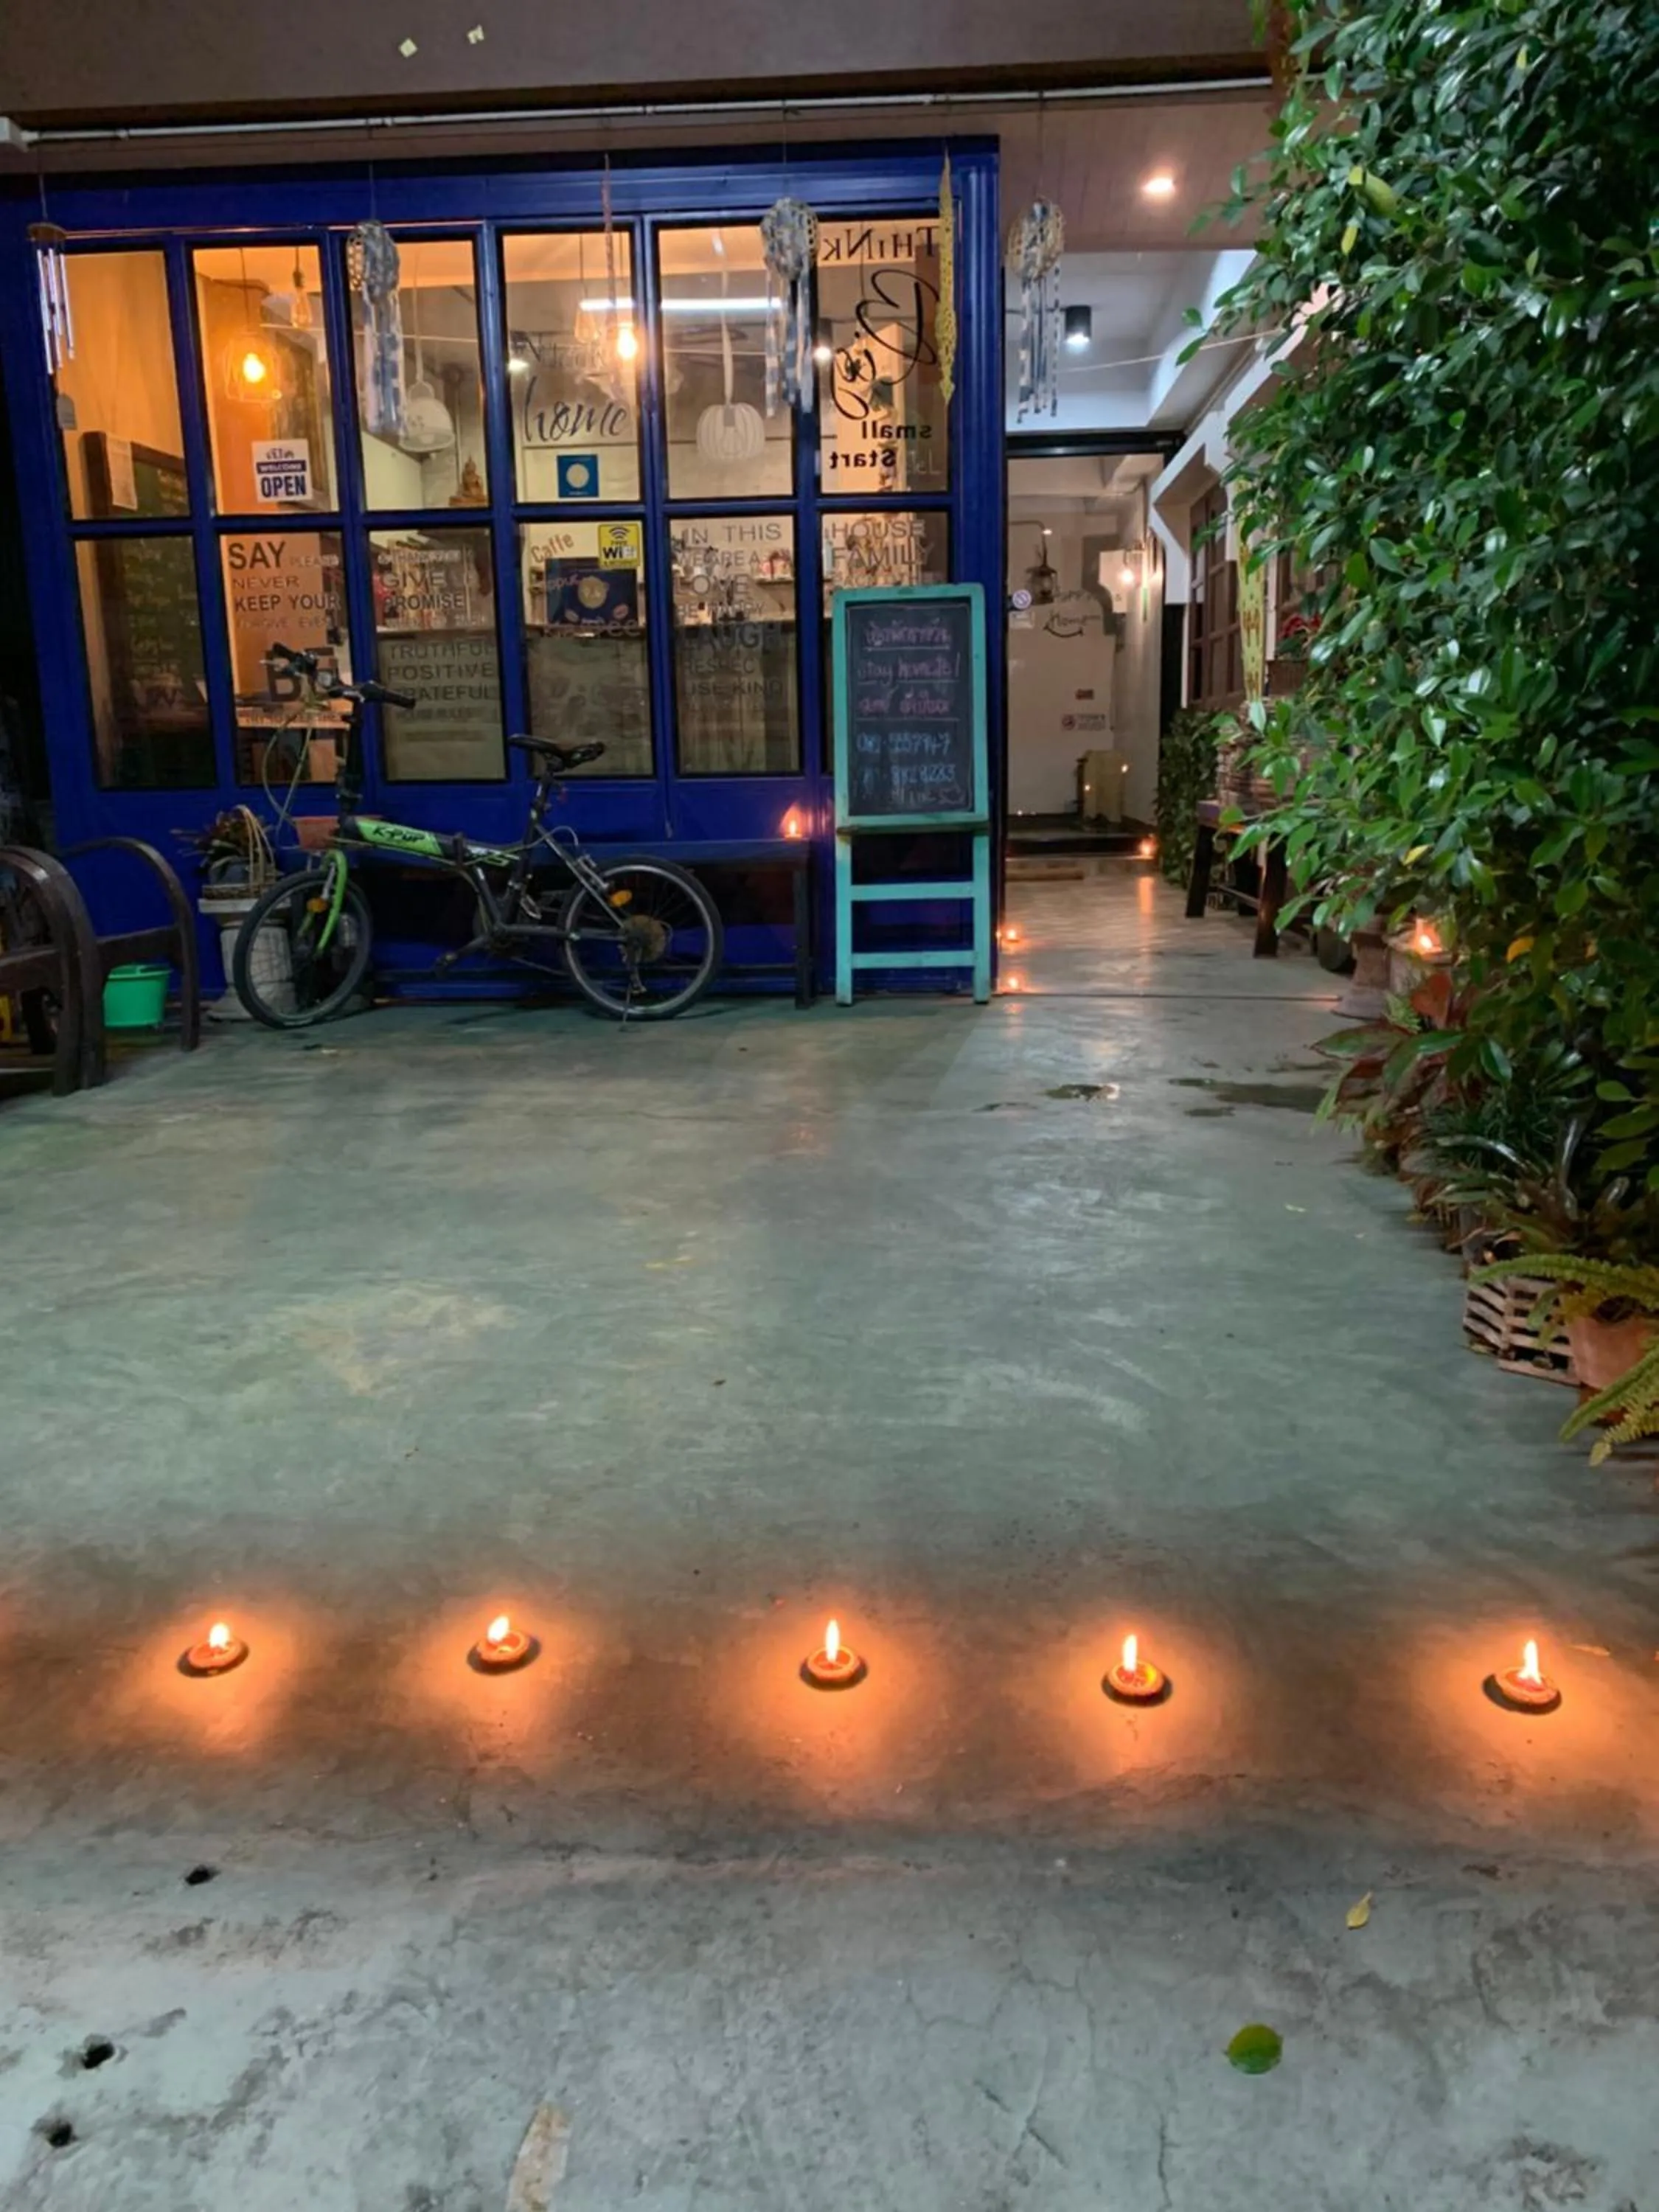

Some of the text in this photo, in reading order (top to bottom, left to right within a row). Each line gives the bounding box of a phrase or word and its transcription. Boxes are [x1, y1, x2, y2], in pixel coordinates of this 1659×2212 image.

[524, 376, 627, 442] home
[261, 475, 307, 498] OPEN
[682, 519, 926, 544] IN THIS HOUSE
[228, 541, 285, 569] SAY
[531, 533, 574, 564] Caffe
[832, 545, 935, 568] FAMILY
[232, 571, 448, 591] NEVER GIVE
[234, 594, 465, 612] KEEP YOUR PROMISE
[388, 662, 494, 680] POSITIVE
[396, 684, 491, 702] RATEFUL
